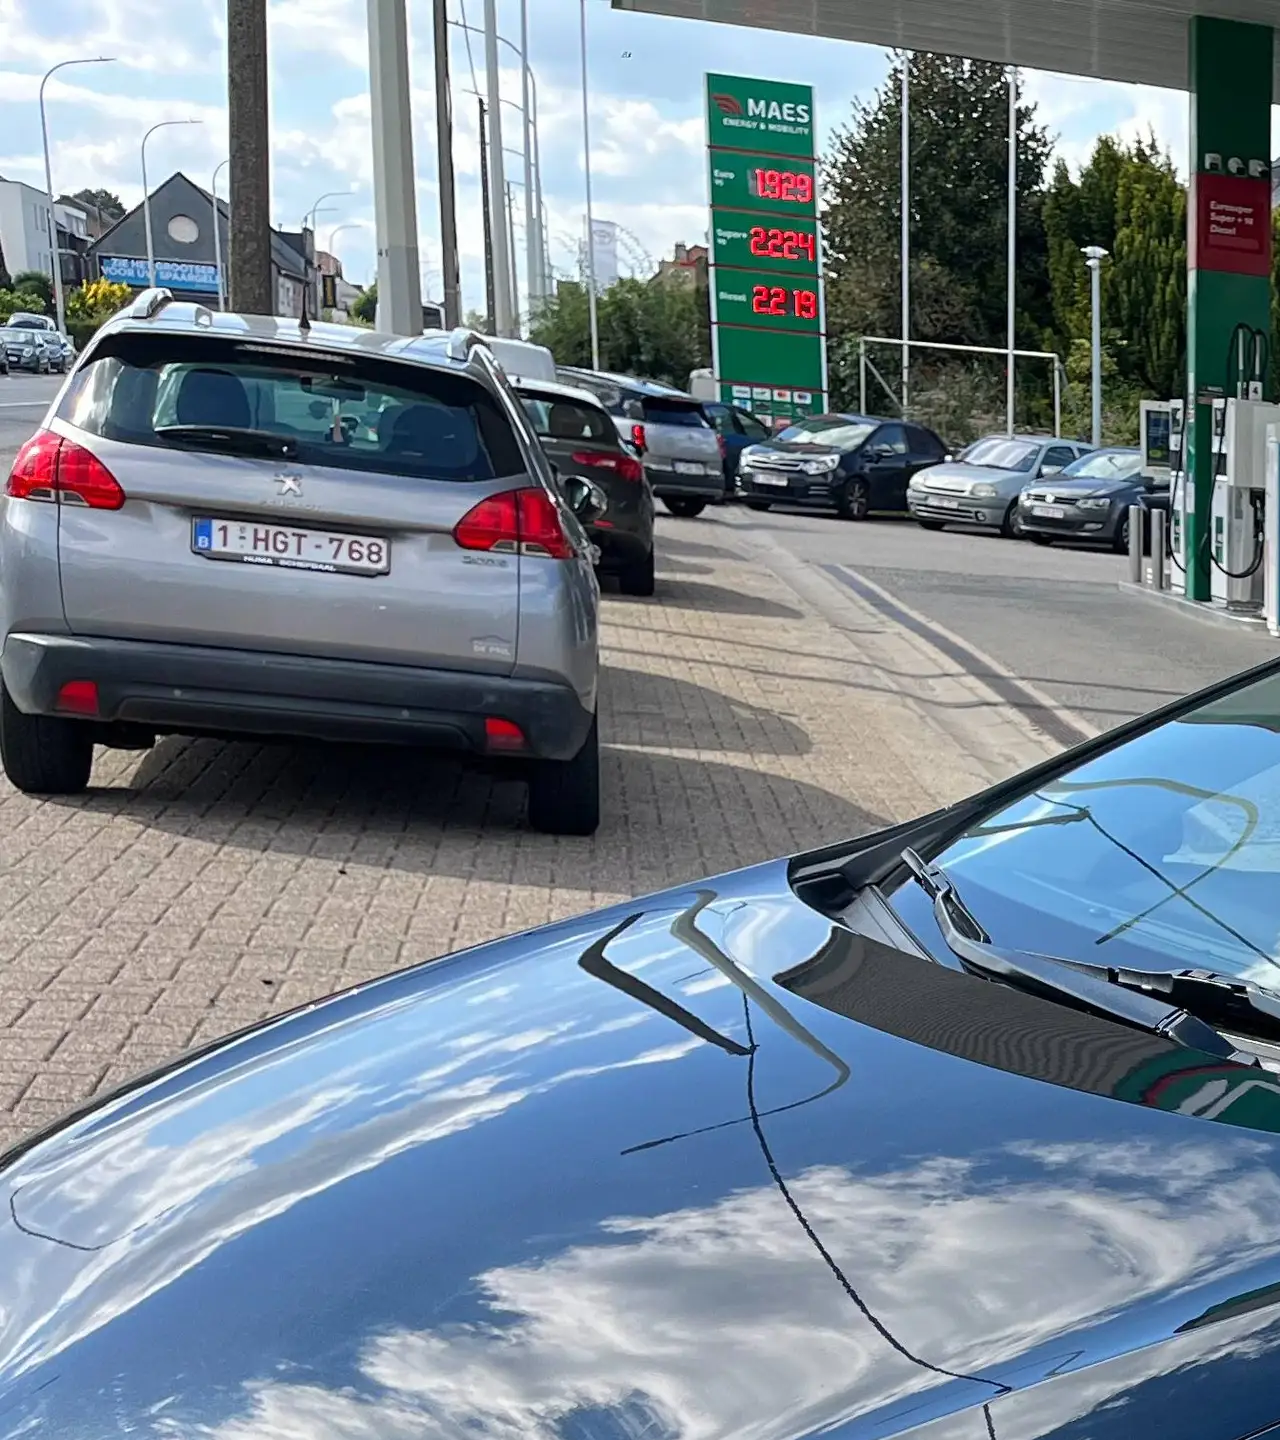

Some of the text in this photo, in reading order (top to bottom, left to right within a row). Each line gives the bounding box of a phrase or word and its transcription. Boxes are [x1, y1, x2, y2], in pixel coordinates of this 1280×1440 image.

[747, 98, 810, 123] MAES
[723, 117, 758, 130] ENERGY
[768, 123, 810, 136] MOBILITY
[713, 169, 735, 180] Euro
[197, 535, 209, 549] B
